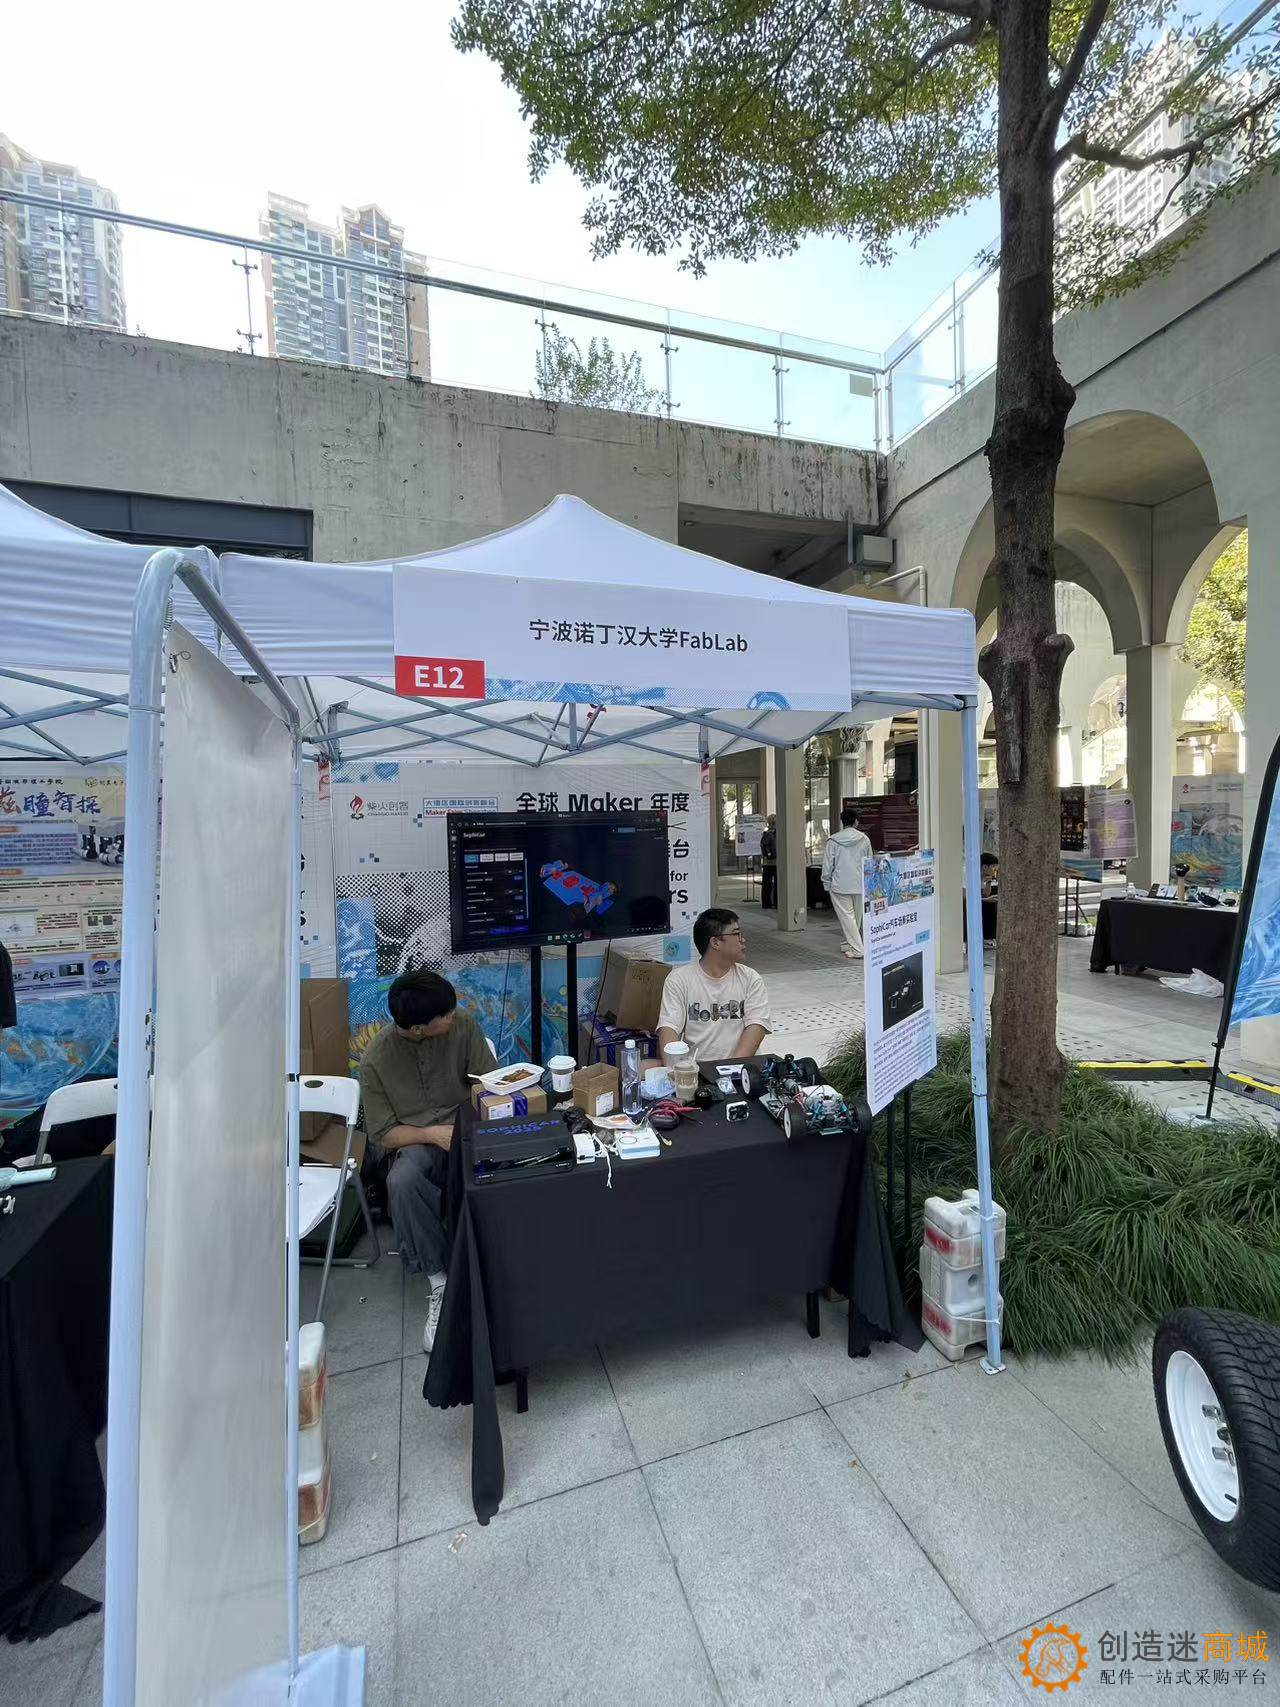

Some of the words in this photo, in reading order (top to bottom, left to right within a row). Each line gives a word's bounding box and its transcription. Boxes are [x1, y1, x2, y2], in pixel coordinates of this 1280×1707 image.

[529, 619, 748, 652] 宁波诺丁汉大学FabLab
[414, 665, 465, 690] E12
[516, 792, 559, 812] 全球
[568, 792, 643, 812] Maker
[650, 792, 690, 812] 年度
[668, 839, 690, 859] 台
[670, 870, 689, 881] for
